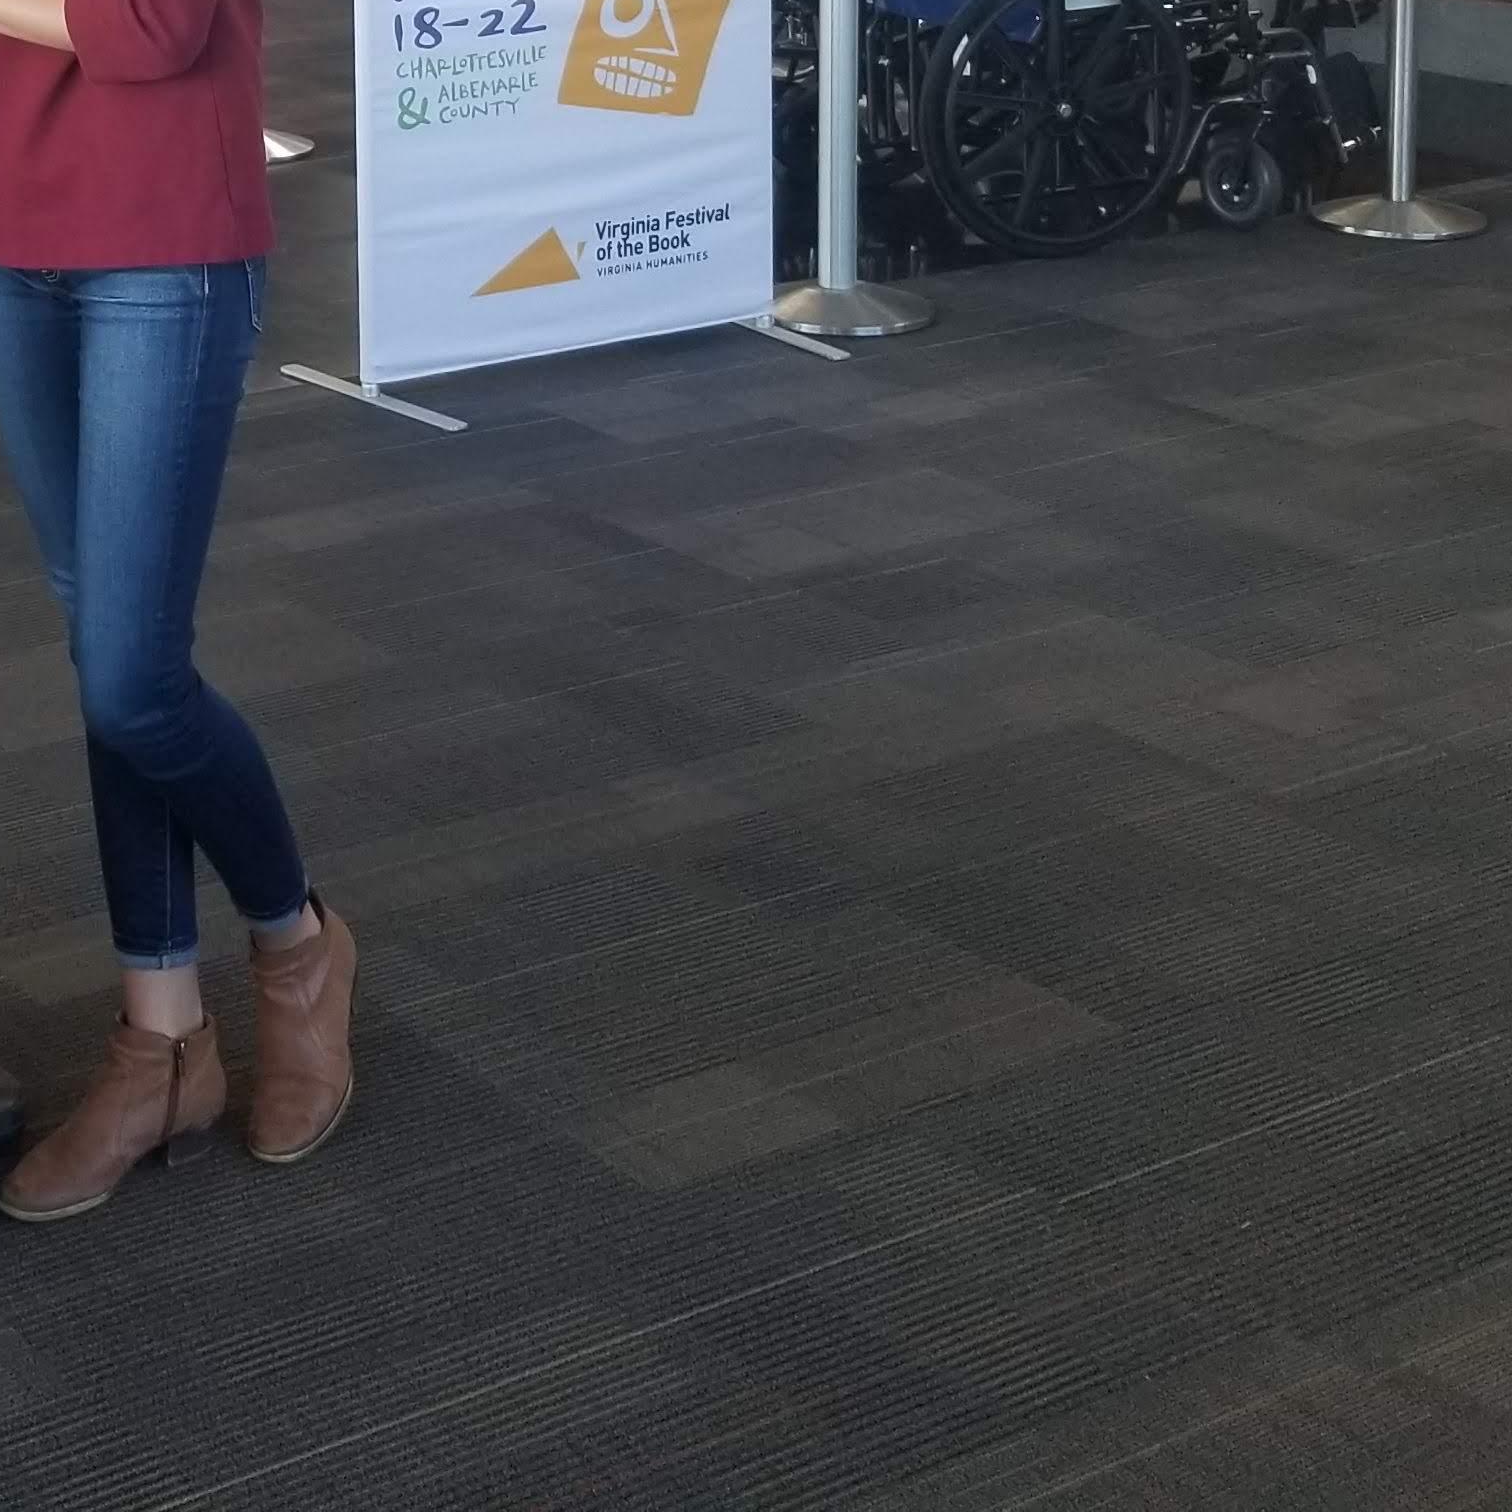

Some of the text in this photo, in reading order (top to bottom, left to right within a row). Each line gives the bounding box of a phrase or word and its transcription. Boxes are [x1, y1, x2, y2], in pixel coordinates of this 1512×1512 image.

[396, 45, 547, 80] CHARLOTTESVILLE
[398, 72, 539, 130] & ALBEMARLE
[439, 98, 520, 124] COUNTY
[596, 203, 730, 241] Virginia Festival
[596, 229, 691, 261] of the Book
[597, 251, 709, 277] VIRGINIA HUMANITIES
